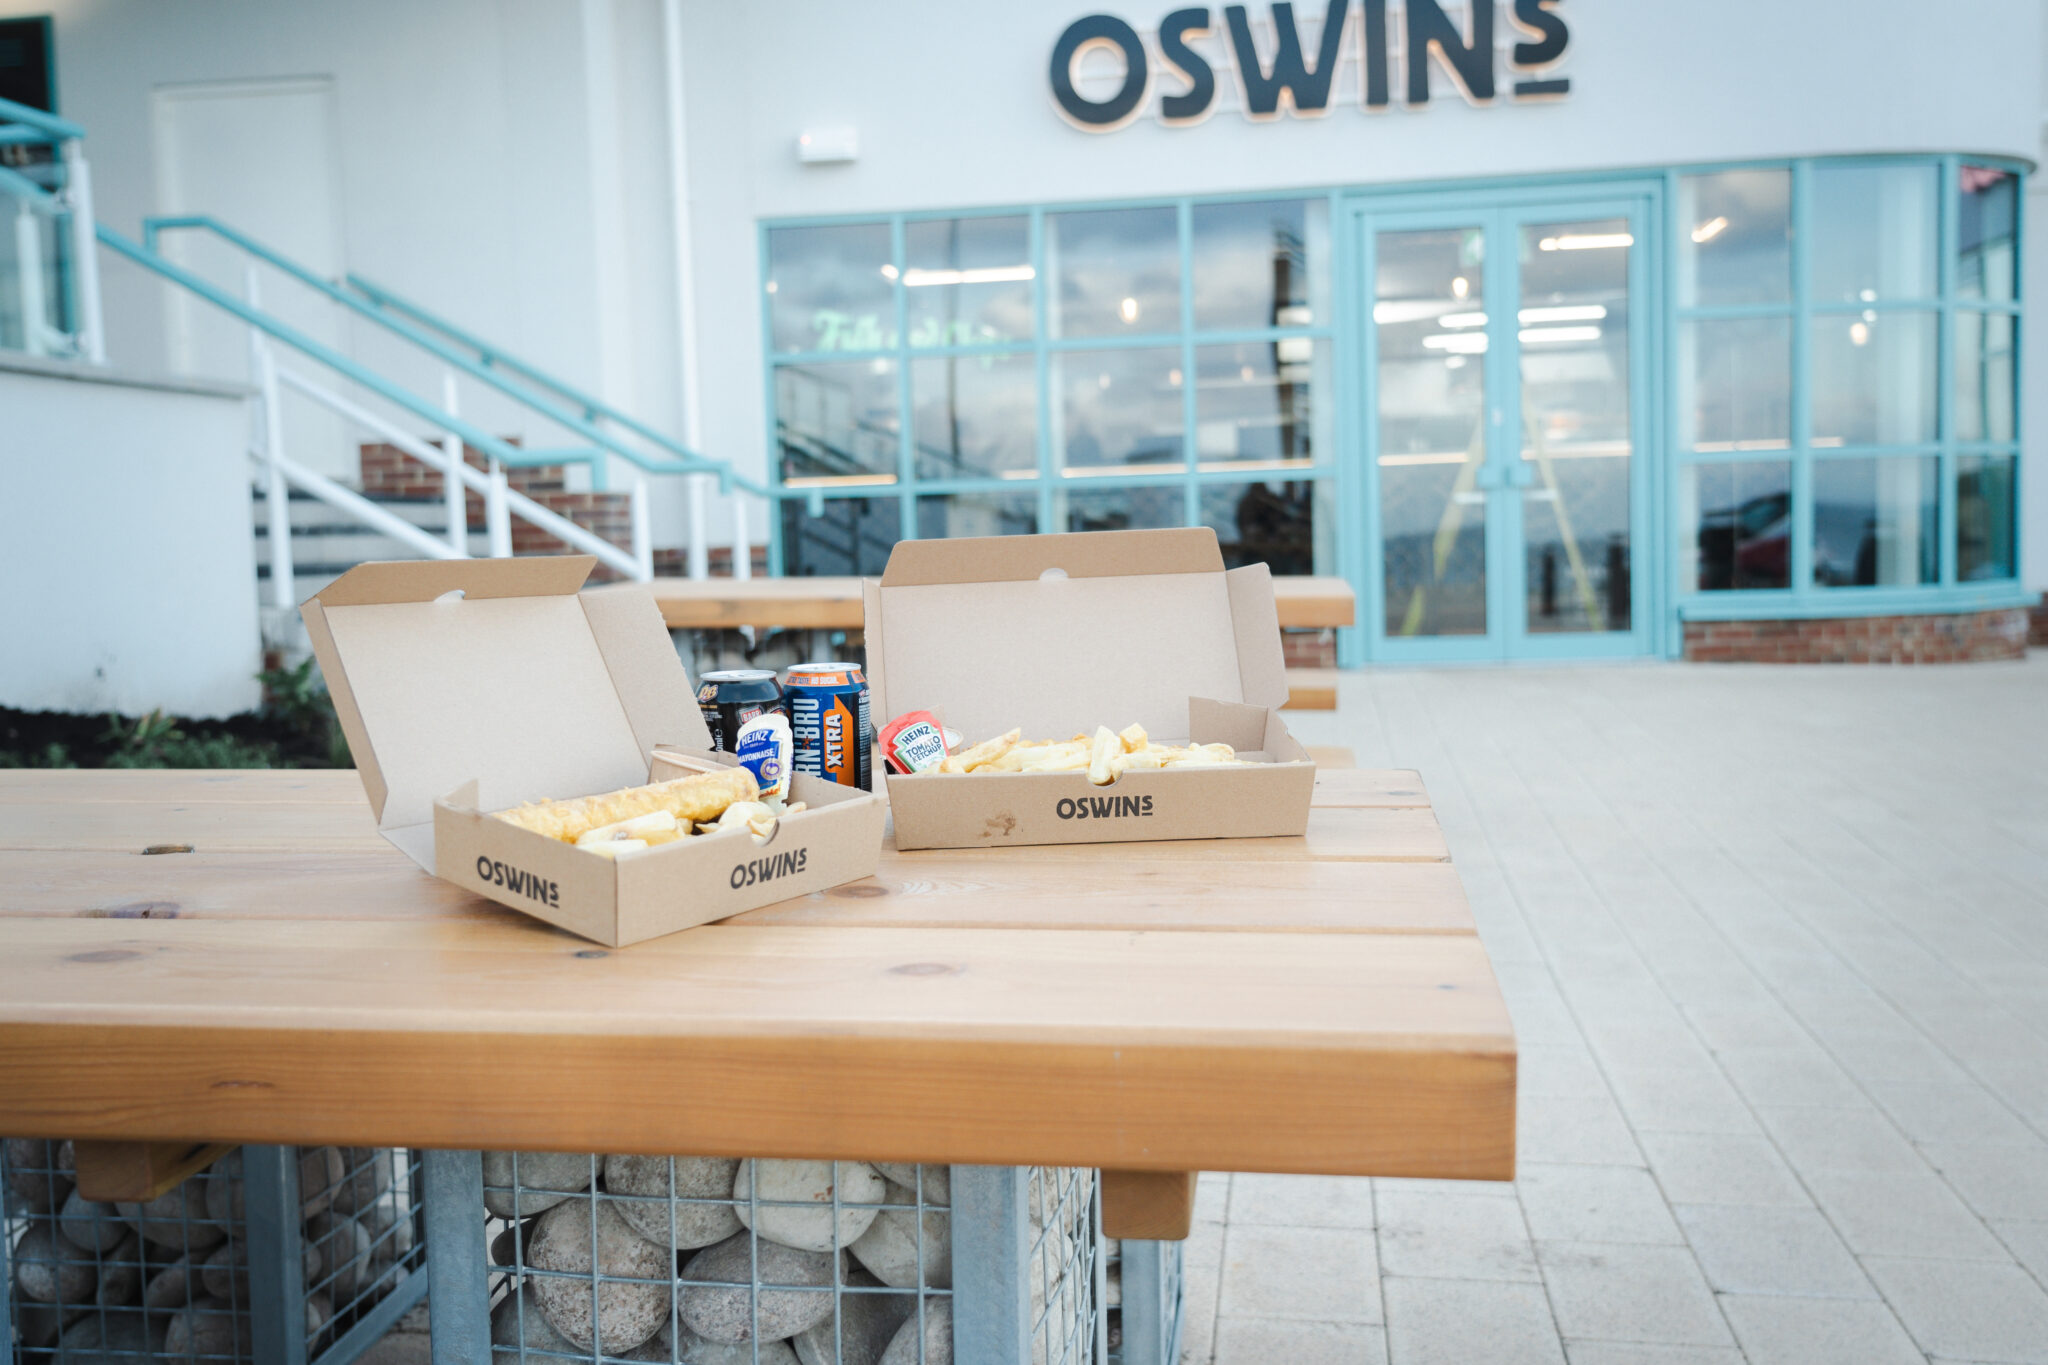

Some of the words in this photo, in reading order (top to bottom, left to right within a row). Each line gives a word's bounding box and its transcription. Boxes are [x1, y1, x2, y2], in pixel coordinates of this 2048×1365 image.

[1050, 0, 1570, 127] OSWINS
[742, 731, 768, 746] HEINZ
[826, 713, 843, 768] XTRA
[902, 726, 930, 745] HEINZ
[906, 736, 940, 757] TOMATO
[738, 748, 775, 762] MAYONNAISE
[912, 744, 941, 763] KETCHUP
[1056, 795, 1153, 819] OSWINS
[730, 848, 807, 889] OSWINS
[476, 856, 560, 908] OSWINS
